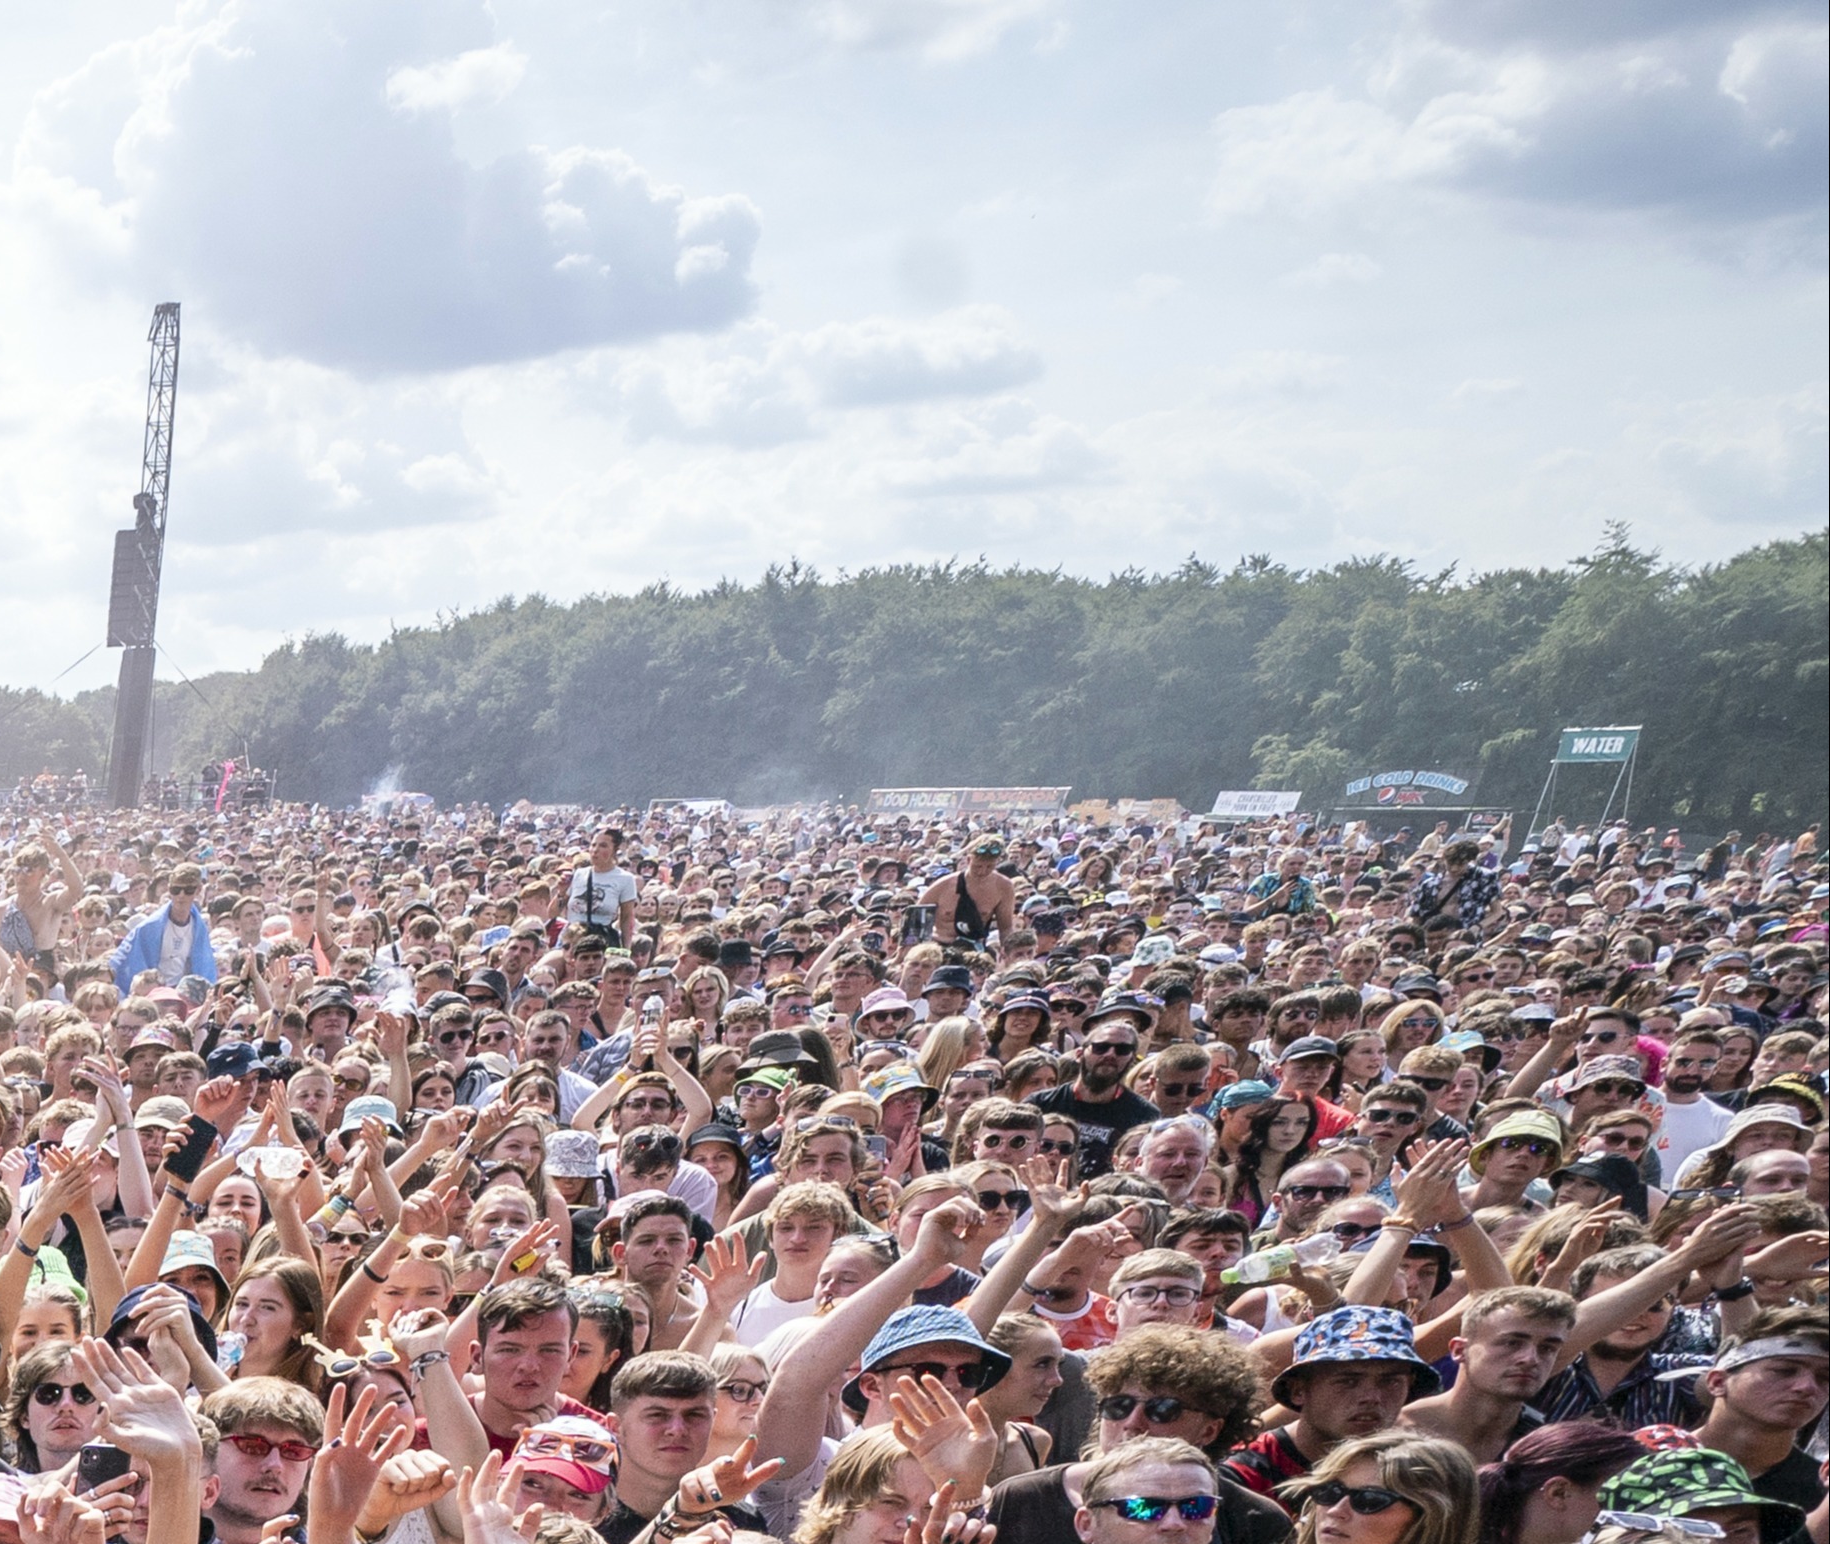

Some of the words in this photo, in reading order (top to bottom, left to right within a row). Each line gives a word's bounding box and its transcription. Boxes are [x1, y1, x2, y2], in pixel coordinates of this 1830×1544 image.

[1570, 736, 1626, 755] WATER
[1346, 776, 1372, 796] ICE
[1372, 770, 1414, 788] COLD
[1412, 771, 1469, 795] DRINKS
[883, 792, 908, 808] DOG
[909, 792, 952, 808] HOUSE
